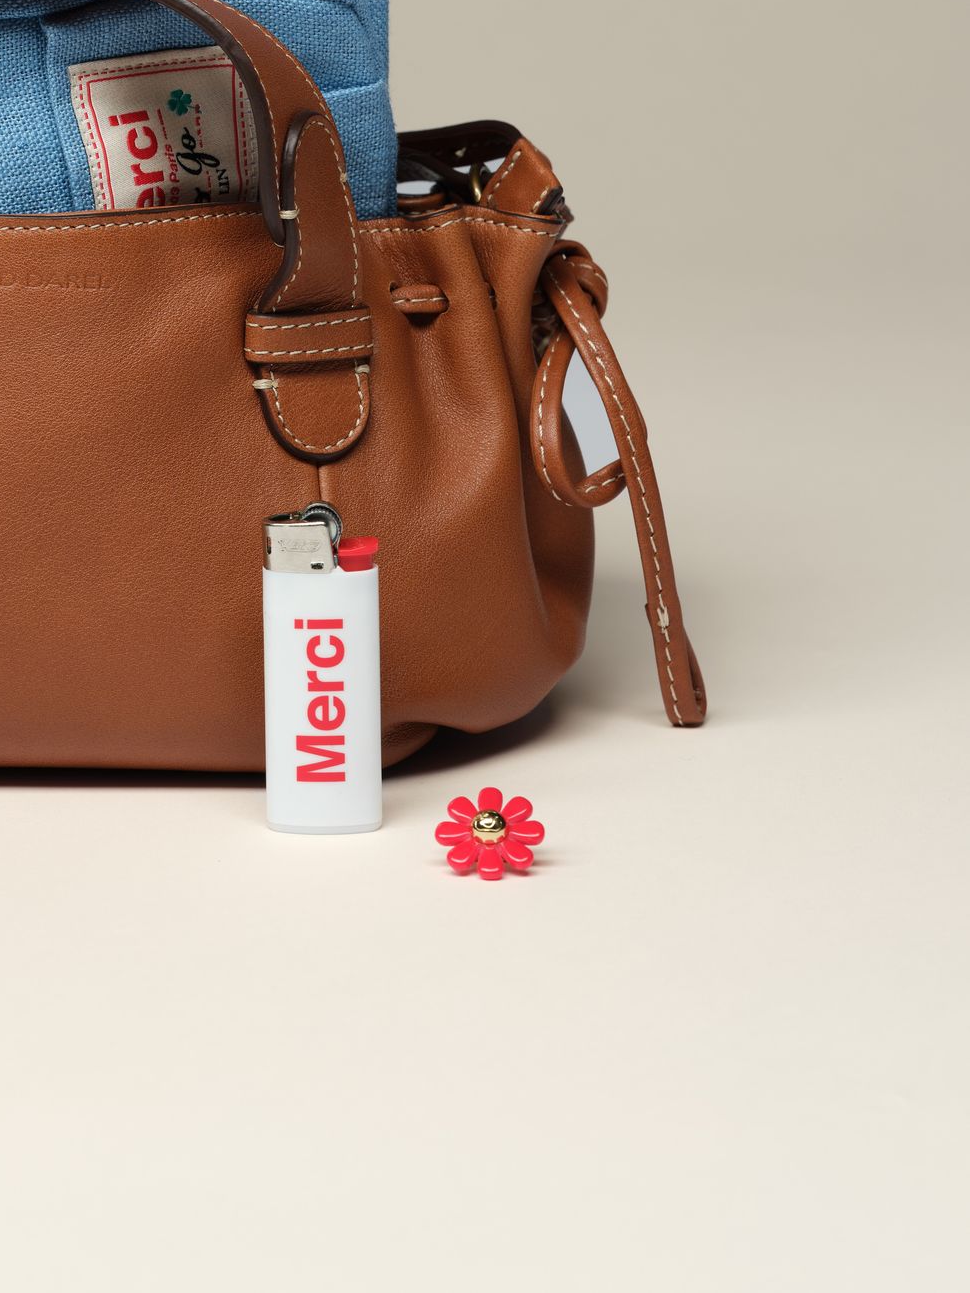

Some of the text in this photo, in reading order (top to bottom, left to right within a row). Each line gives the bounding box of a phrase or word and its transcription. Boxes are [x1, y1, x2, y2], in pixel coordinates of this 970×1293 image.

[108, 109, 166, 207] erci
[164, 144, 179, 182] Paris
[176, 126, 220, 175] go
[294, 618, 346, 783] Merci
